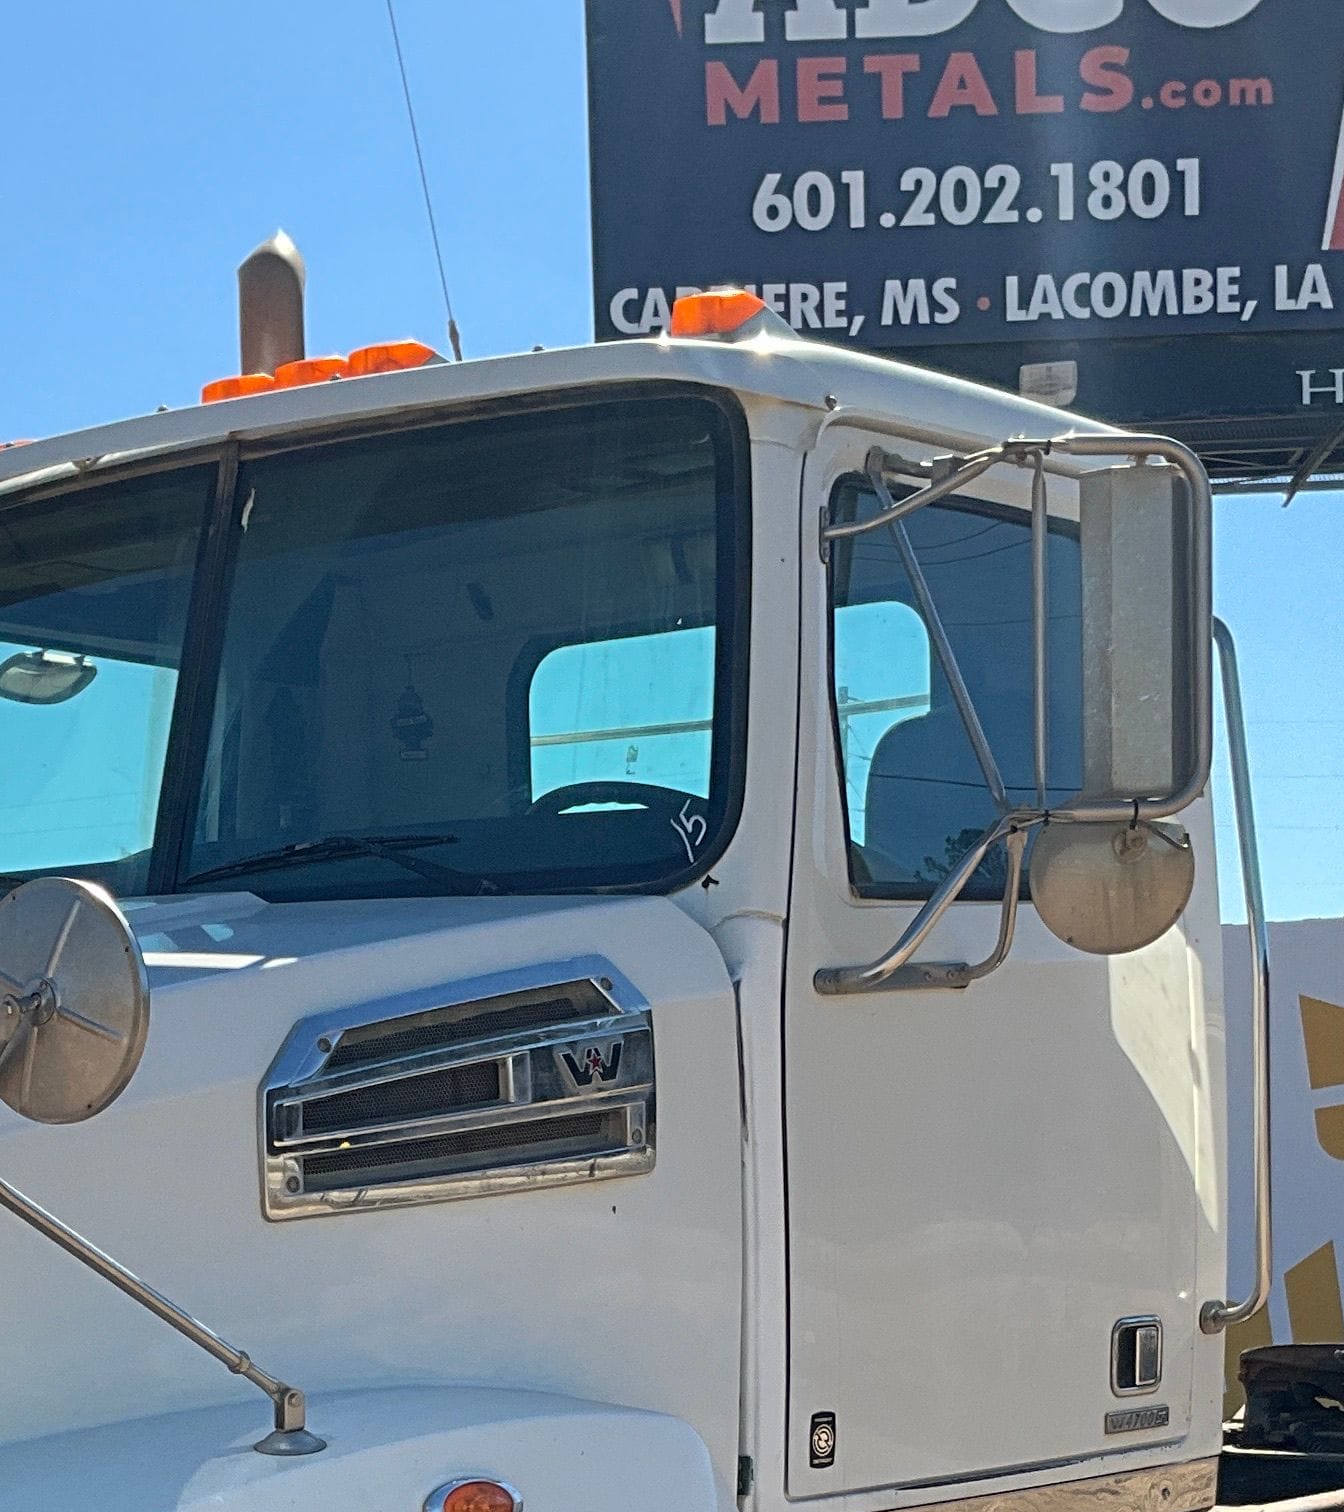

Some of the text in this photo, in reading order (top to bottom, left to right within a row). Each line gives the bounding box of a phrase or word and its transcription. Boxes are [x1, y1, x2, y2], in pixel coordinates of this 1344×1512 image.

[705, 45, 1274, 127] METALS.com
[752, 157, 1200, 233] 601.202.1801
[881, 277, 960, 326] MS
[1005, 266, 1258, 322] LACOMBE,
[1274, 263, 1334, 311] LA
